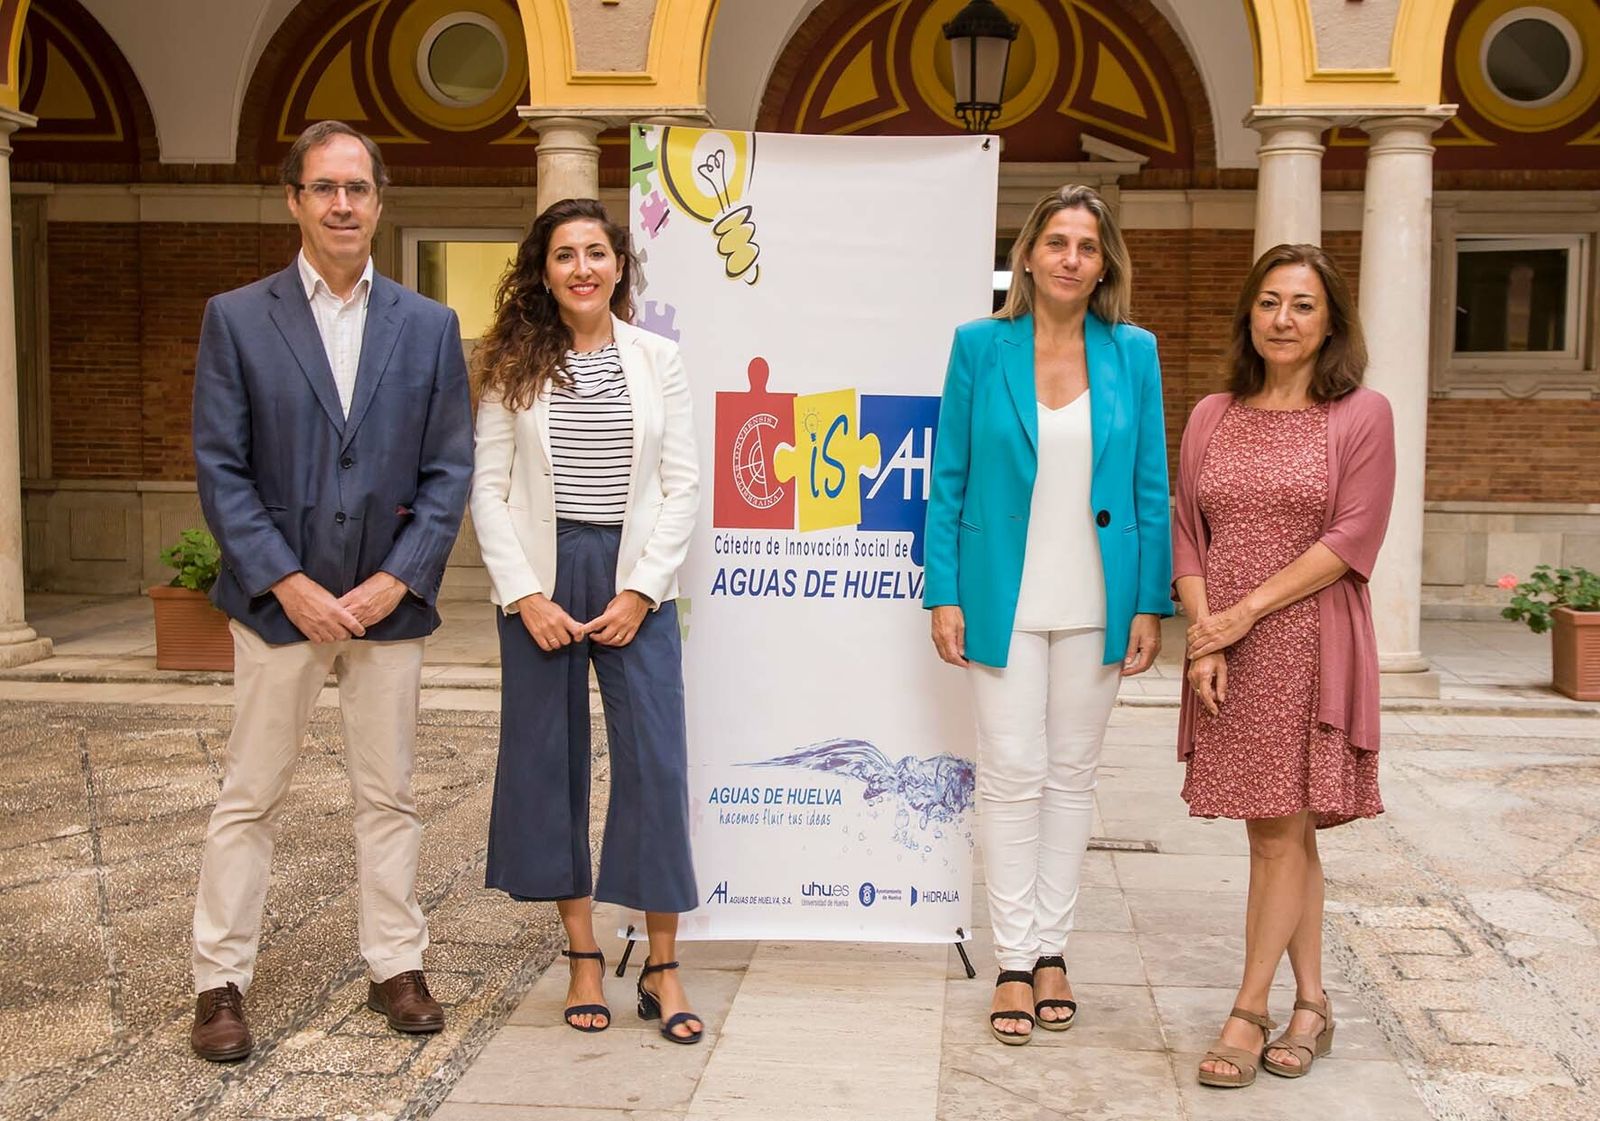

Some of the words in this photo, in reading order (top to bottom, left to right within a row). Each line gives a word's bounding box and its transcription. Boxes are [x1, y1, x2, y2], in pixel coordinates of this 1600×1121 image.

[714, 533, 761, 555] Cátedra
[766, 536, 780, 556] de
[785, 536, 849, 558] Innovación
[854, 538, 890, 558] Social
[894, 538, 908, 558] de
[710, 567, 797, 597] AGUAS
[803, 569, 838, 598] DE
[843, 570, 925, 599] HUELV
[708, 787, 760, 804] AGUAS
[763, 788, 784, 805] DE
[786, 788, 842, 806] HUELVA
[719, 808, 759, 824] hacemos
[763, 808, 784, 825] fluir
[788, 811, 802, 825] tus
[805, 809, 831, 826] ideas
[801, 881, 850, 897] uhu.es
[729, 896, 749, 904] AGUAS
[749, 896, 757, 904] DE
